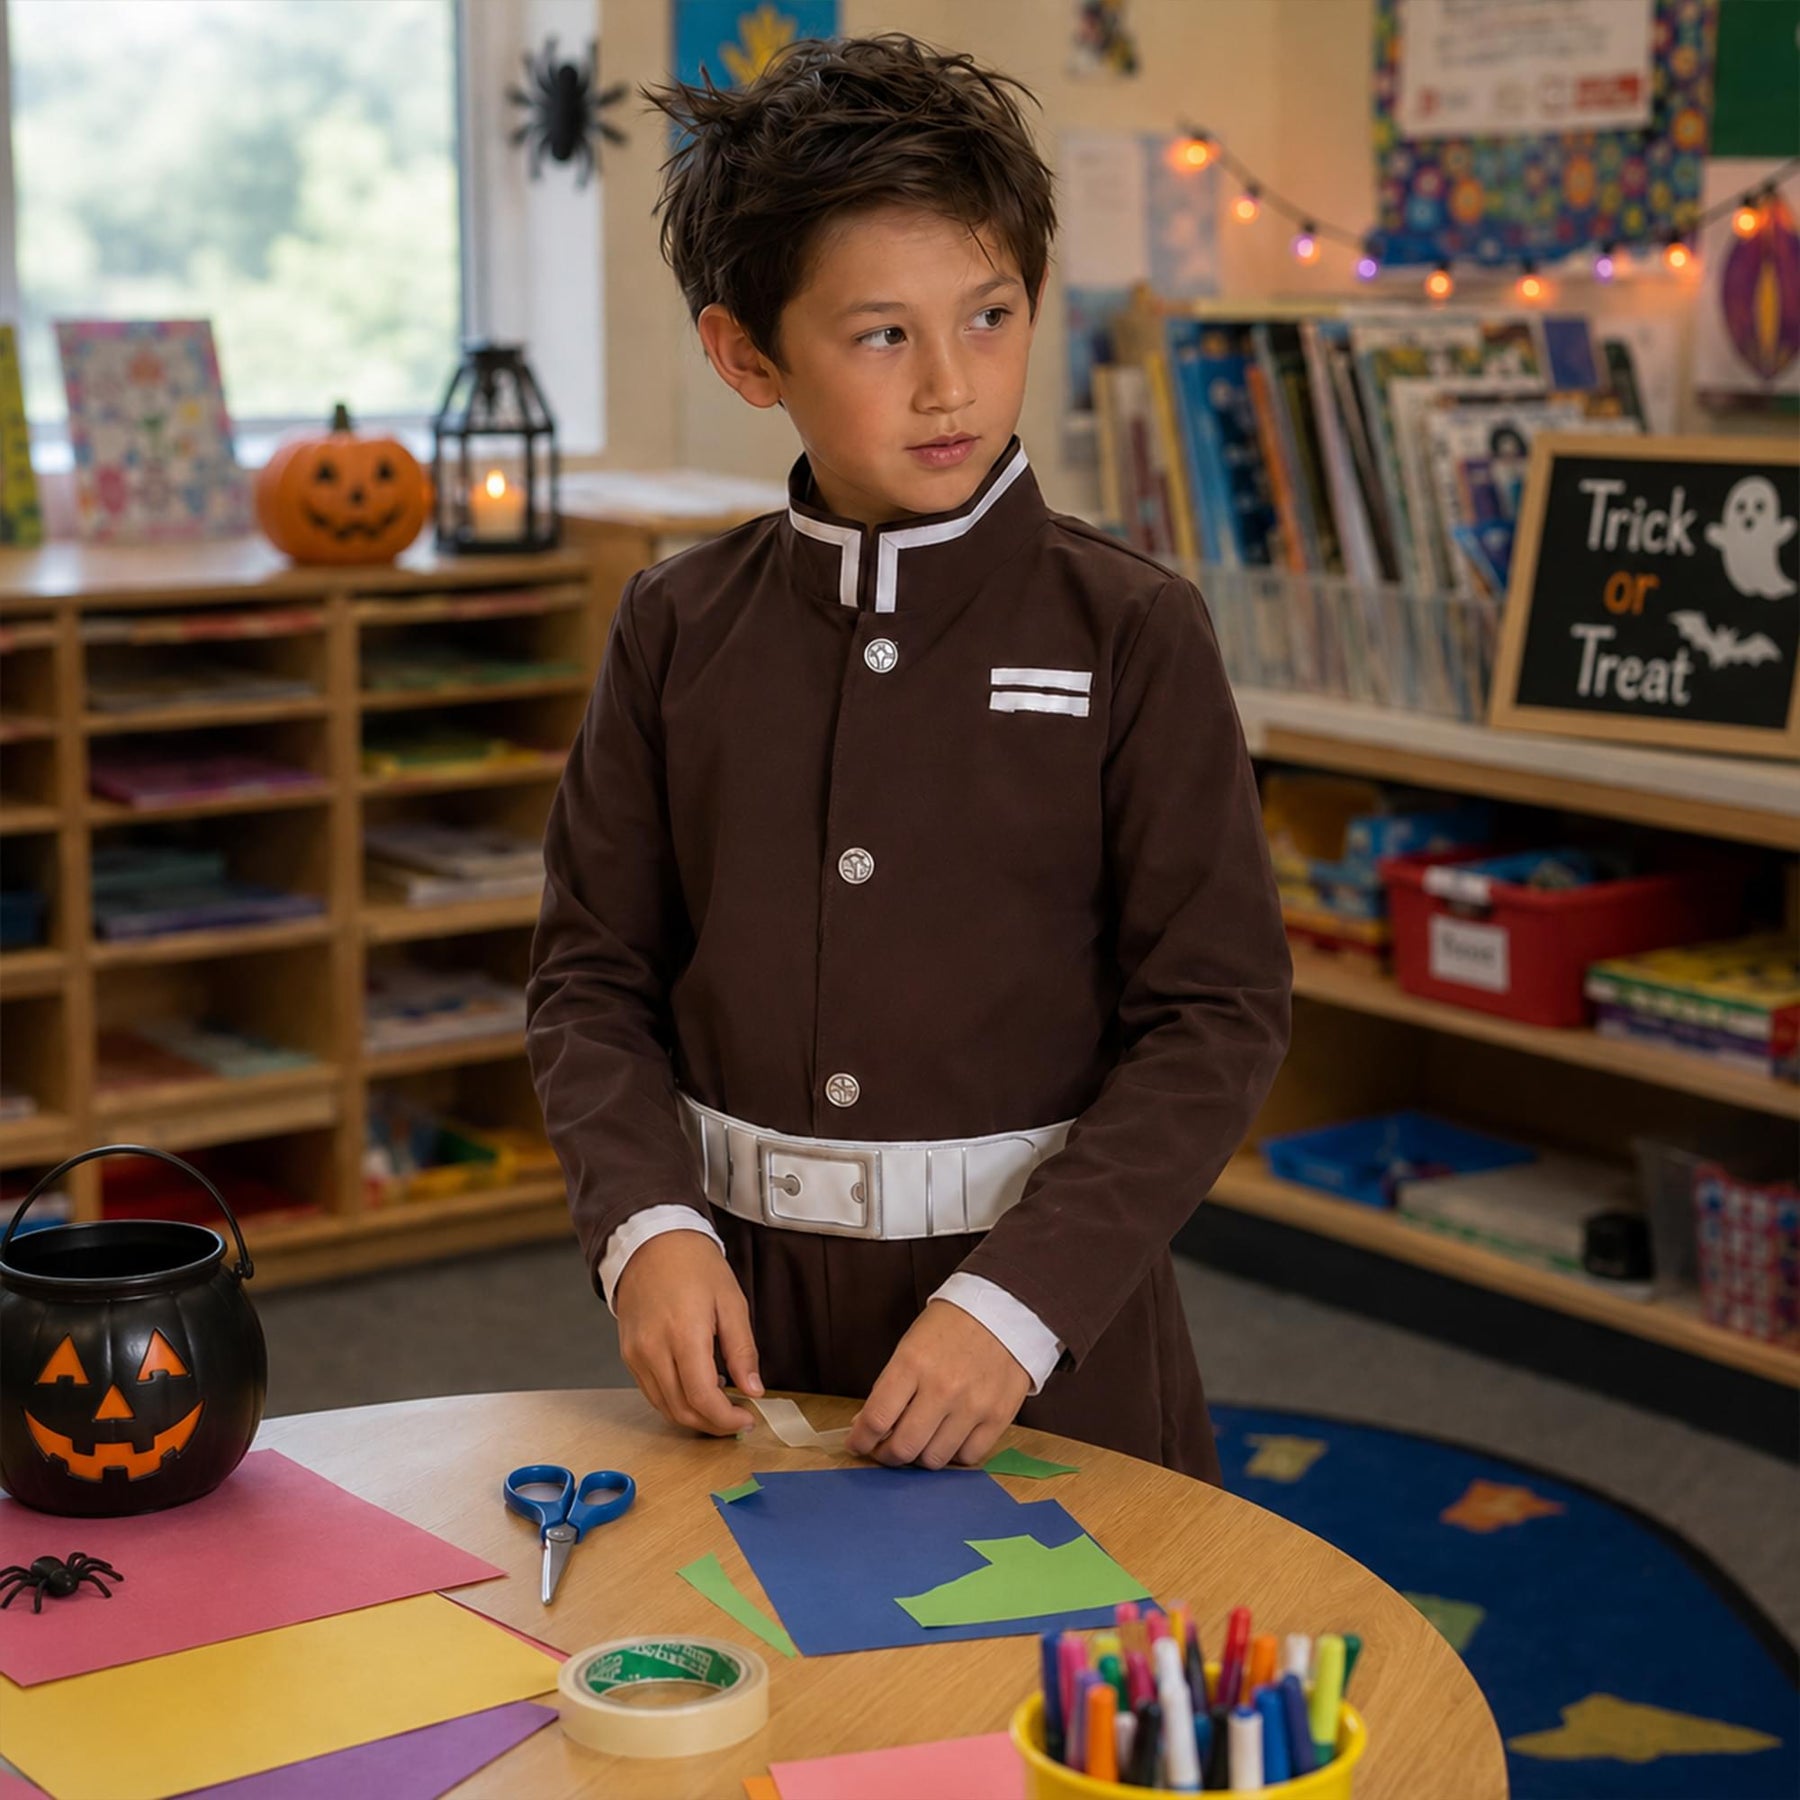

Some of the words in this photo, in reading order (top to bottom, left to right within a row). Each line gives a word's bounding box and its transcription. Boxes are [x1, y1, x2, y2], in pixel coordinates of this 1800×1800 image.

[1580, 479, 1696, 556] Trick
[1604, 571, 1659, 614] or
[1571, 624, 1692, 706] Treat
